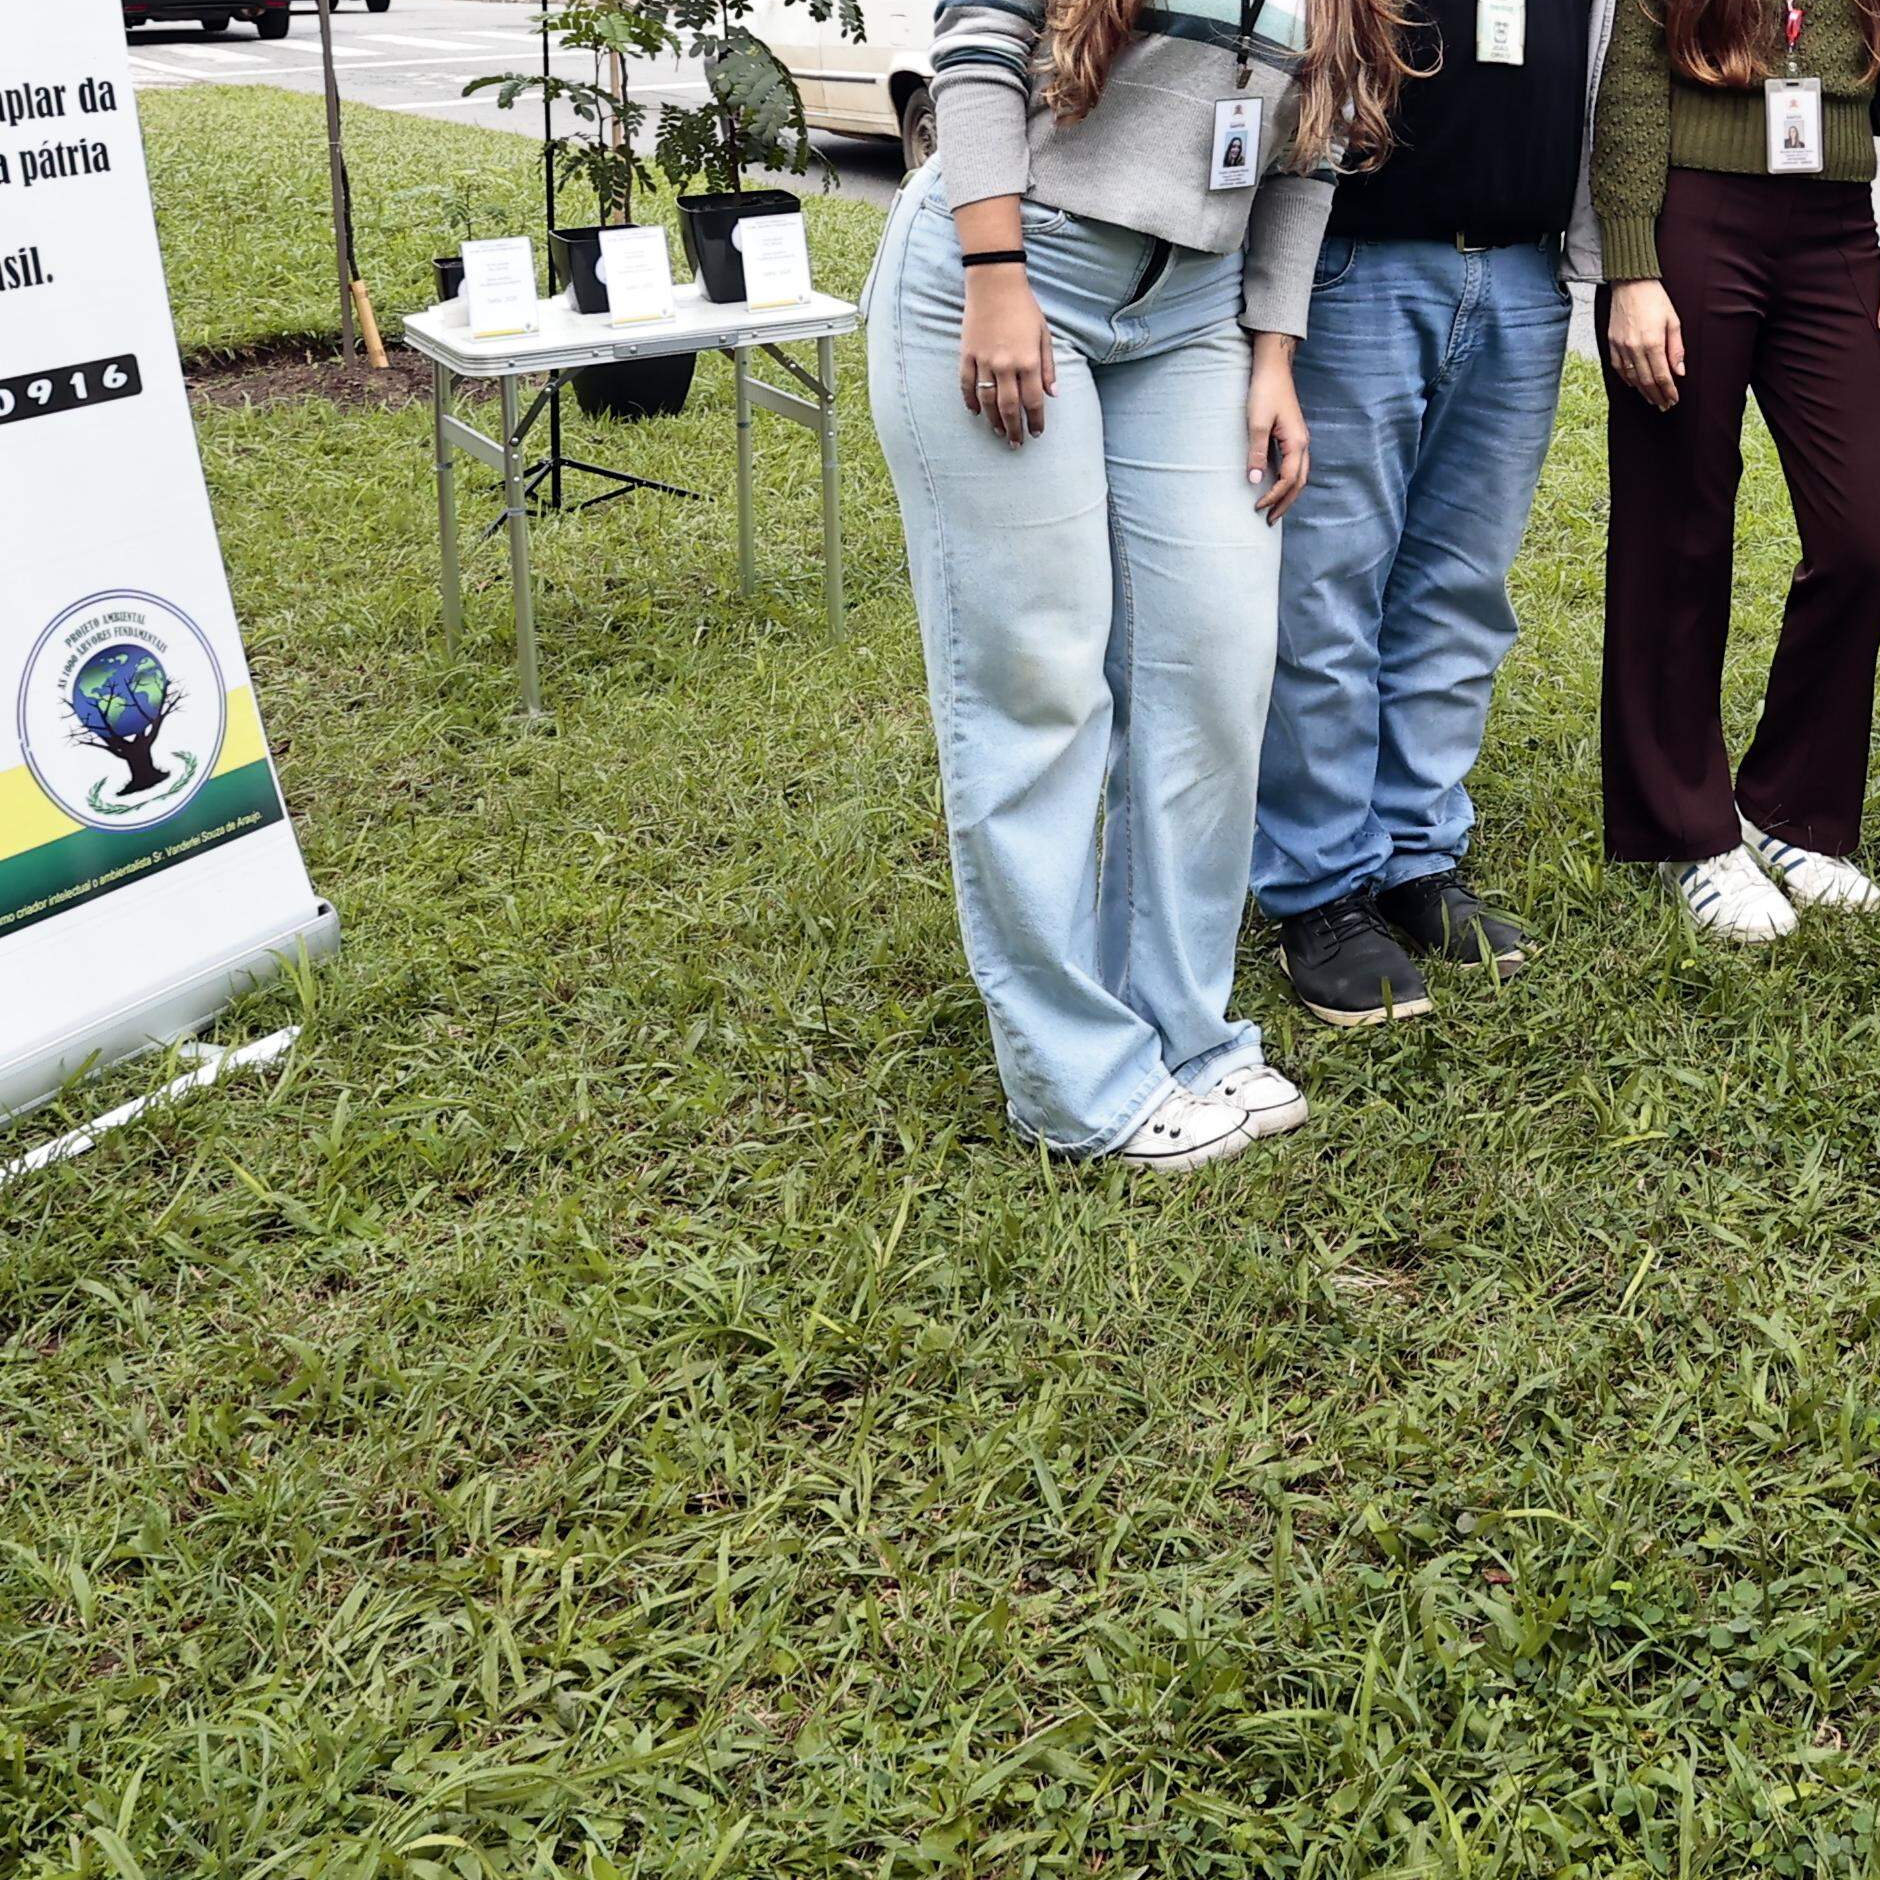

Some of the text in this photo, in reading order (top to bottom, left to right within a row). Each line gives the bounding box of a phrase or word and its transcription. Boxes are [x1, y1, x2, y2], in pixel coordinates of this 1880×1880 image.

[0, 77, 117, 126] plar da
[19, 138, 111, 187] pátria
[0, 246, 53, 291] sil.
[16, 899, 47, 919] criador
[48, 879, 92, 906] intelectual
[99, 856, 152, 885] ambientalista
